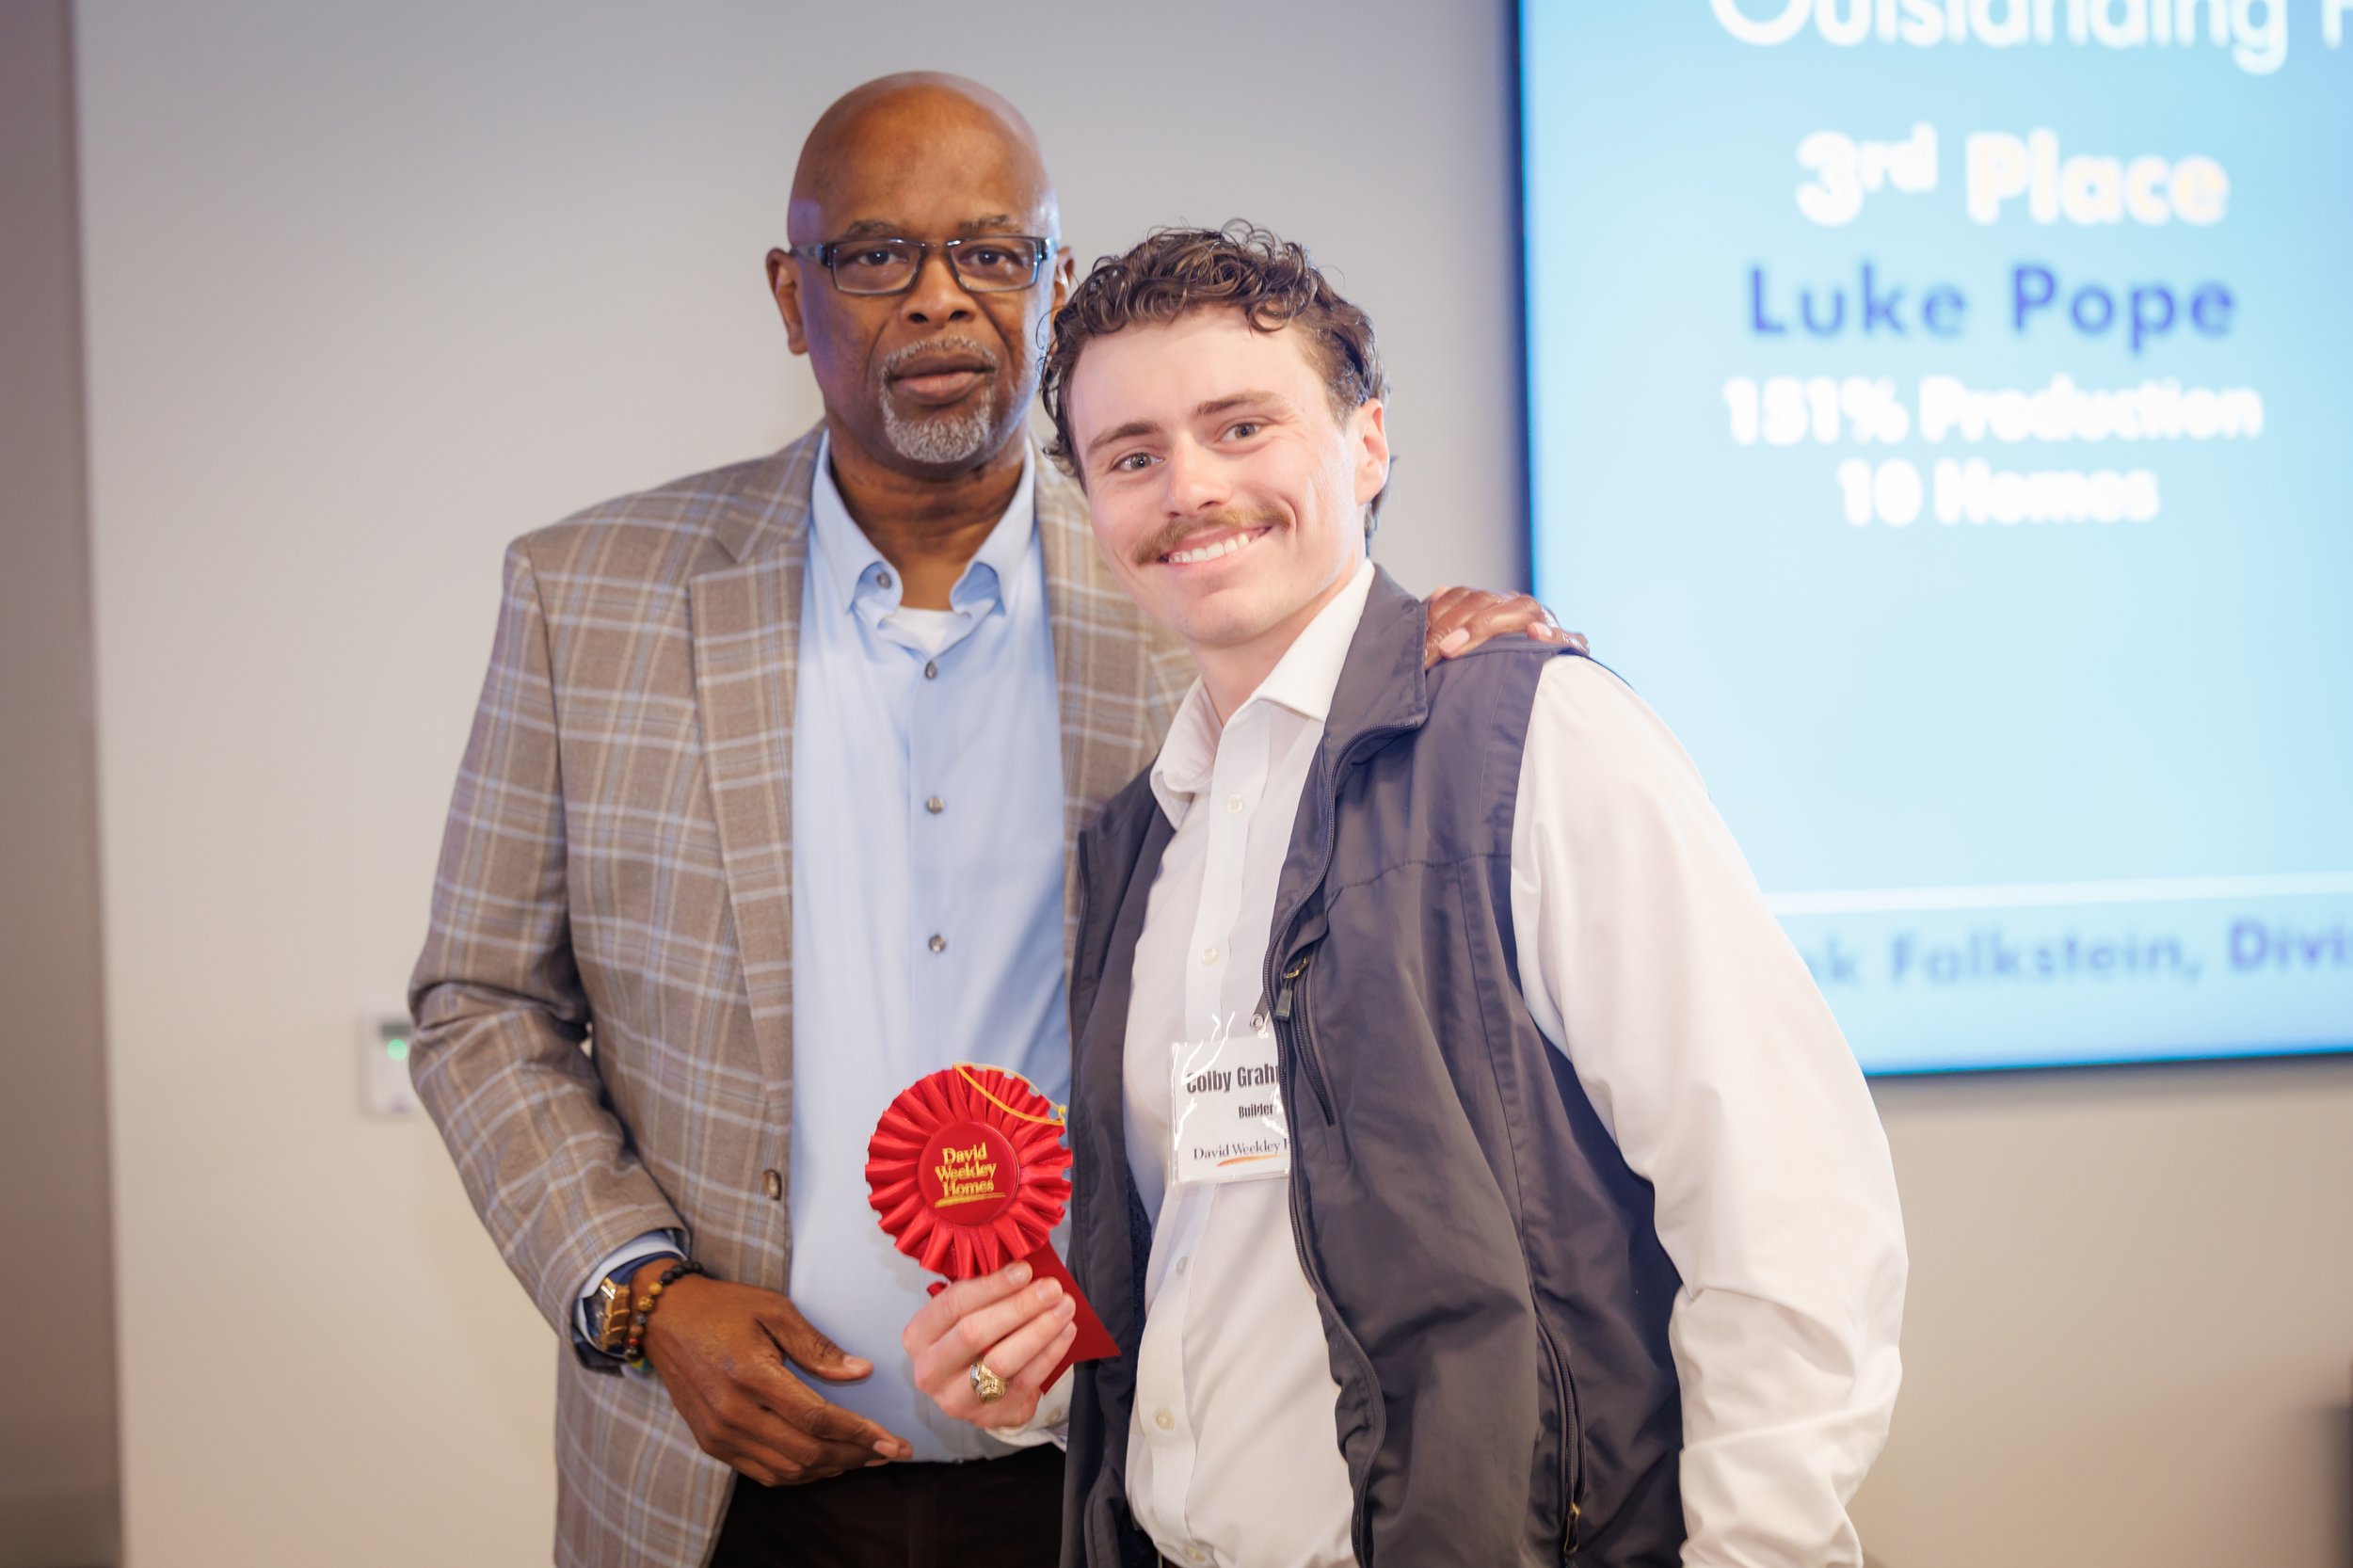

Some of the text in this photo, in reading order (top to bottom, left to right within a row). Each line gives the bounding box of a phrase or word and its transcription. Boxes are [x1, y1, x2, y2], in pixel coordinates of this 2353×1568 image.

[1797, 123, 2231, 225] 3rd Place
[1747, 260, 2238, 358] Luke Pope
[1919, 374, 2264, 442] Production
[1837, 457, 2159, 527] 10 Homes
[2228, 914, 2353, 974] Divi
[1186, 1071, 1231, 1094] Colby
[1239, 1103, 1273, 1119] Builder
[942, 1142, 987, 1165] David
[1193, 1144, 1229, 1160] David
[1231, 1139, 1280, 1156] Weekley
[935, 1160, 997, 1182] Weekley
[942, 1179, 995, 1198] Homes
